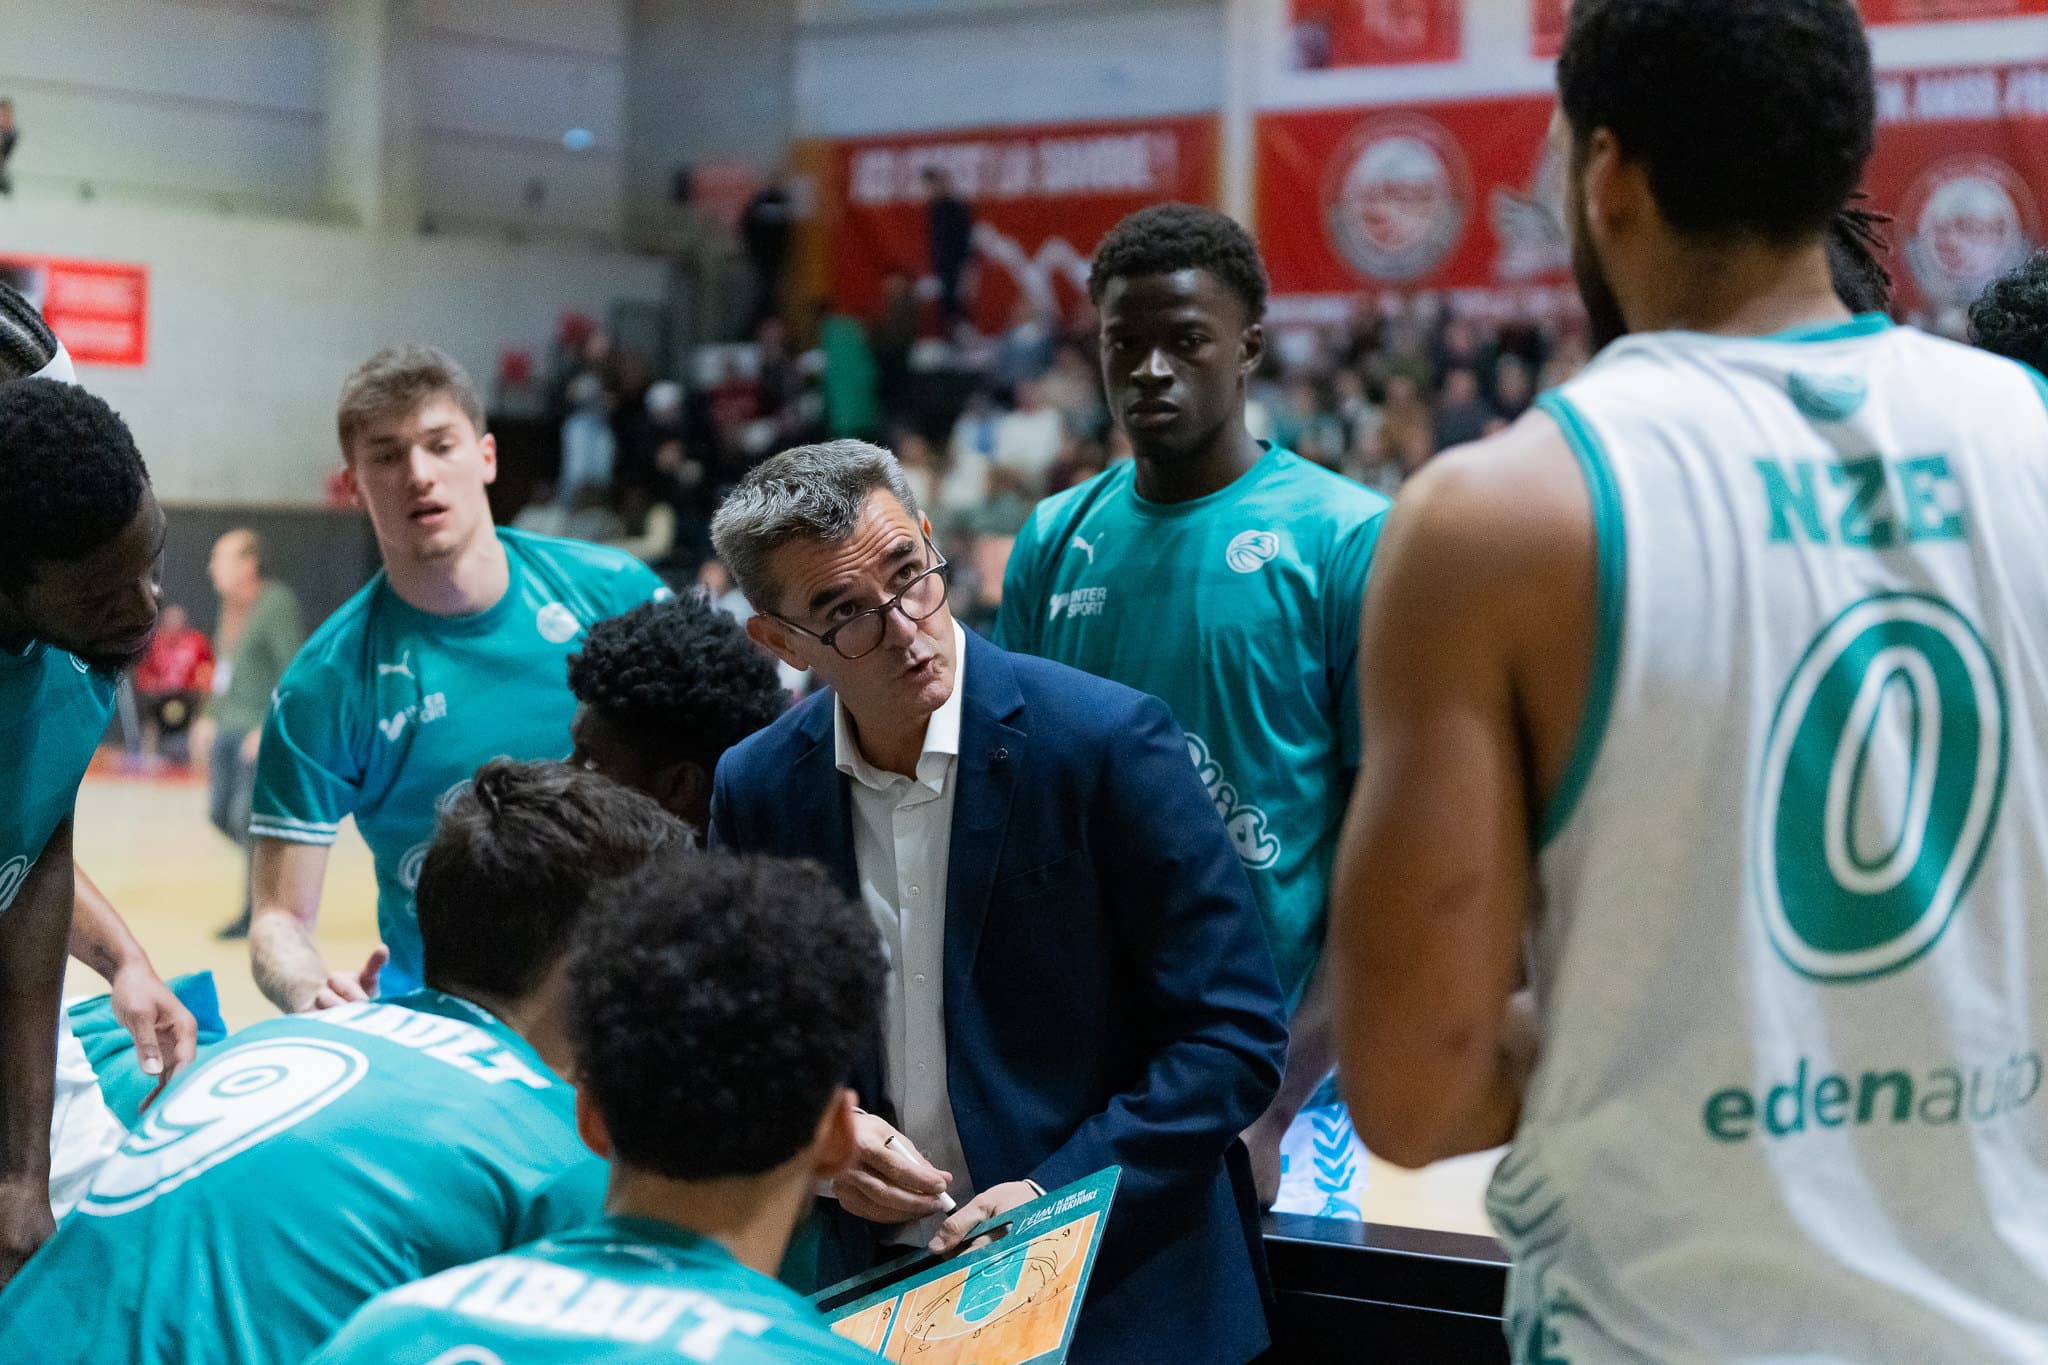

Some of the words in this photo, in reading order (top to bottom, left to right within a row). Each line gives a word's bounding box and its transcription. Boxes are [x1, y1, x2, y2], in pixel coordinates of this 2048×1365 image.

[1754, 454, 1966, 549] NZE
[1066, 601, 1105, 618] SPORT
[1070, 587, 1107, 603] INTER
[1754, 589, 2011, 985] 0
[75, 1036, 370, 1218] 9
